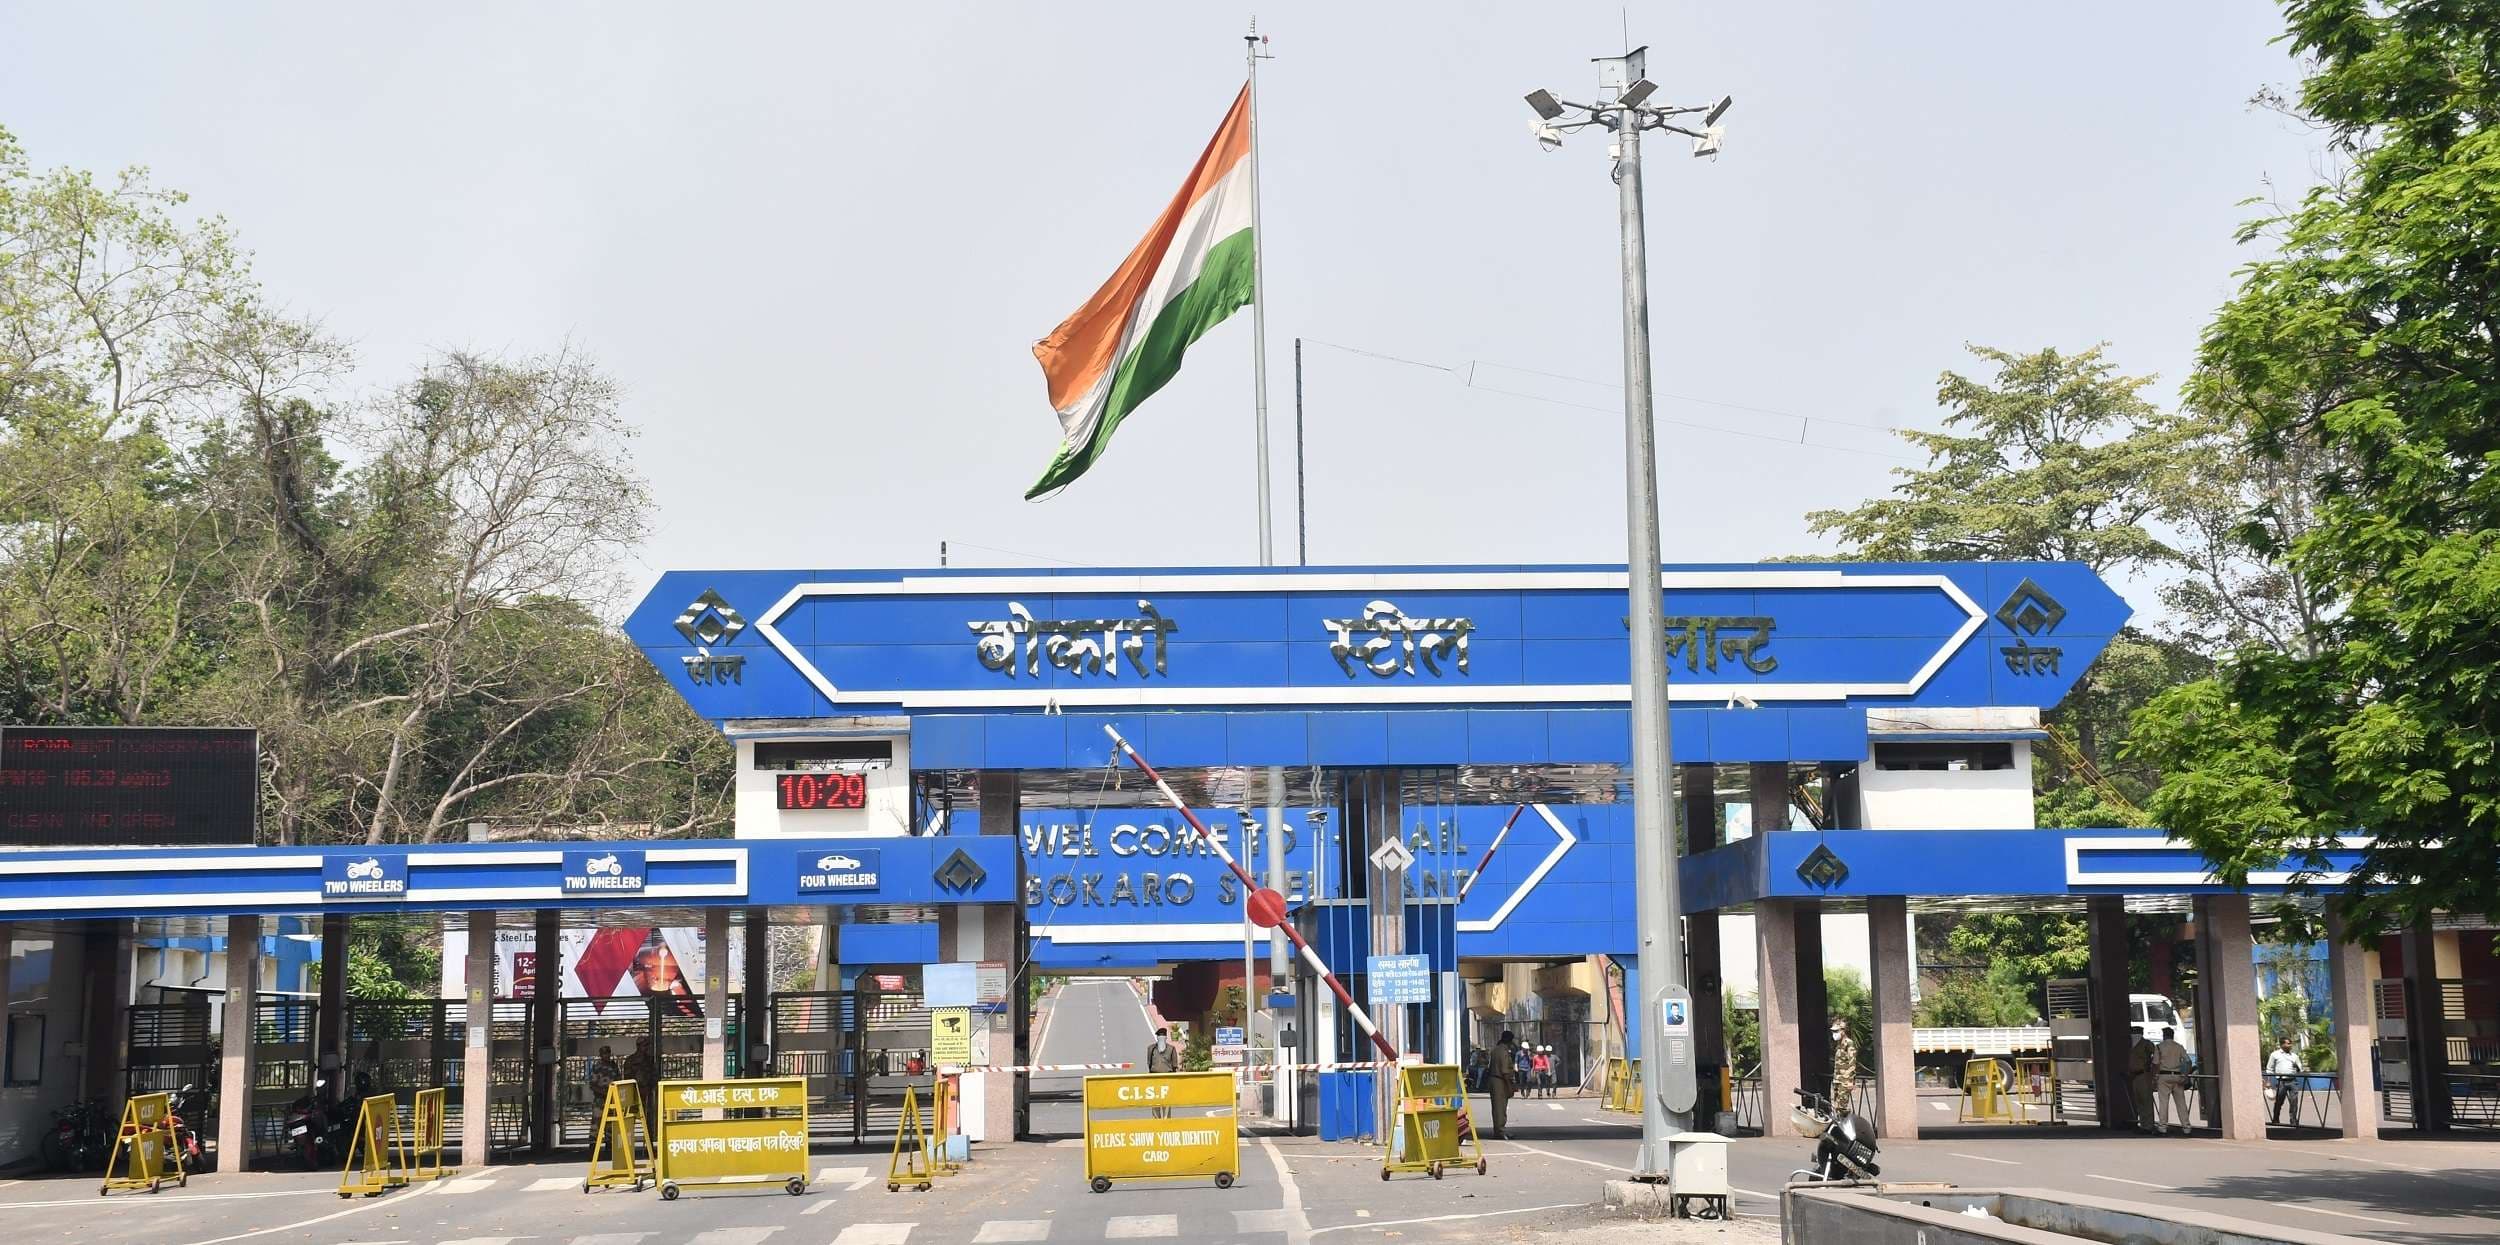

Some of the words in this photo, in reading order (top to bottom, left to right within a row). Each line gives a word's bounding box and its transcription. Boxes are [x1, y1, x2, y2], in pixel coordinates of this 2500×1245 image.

[967, 600, 1178, 679] बोकारो
[1322, 600, 1477, 680] स्टील
[681, 646, 747, 687] सेल
[2000, 638, 2063, 677] सेल
[780, 774, 864, 808] 10:29
[325, 881, 348, 893] TWO
[349, 880, 404, 893] WHEELERS
[565, 877, 588, 889] TWO
[589, 876, 642, 889] WHEELERS
[800, 875, 826, 888] FOUR
[827, 873, 877, 887] WHEELERS
[1025, 872, 1196, 905] BOKARO
[501, 933, 522, 942] Steel
[1094, 1132, 1126, 1149] PLEASE
[1129, 1133, 1154, 1147] SHOW
[1157, 1131, 1183, 1147] YOUR
[1183, 1129, 1221, 1146] IDENTITY
[1424, 1119, 1440, 1139] STOP
[1143, 1150, 1169, 1163] CARD
